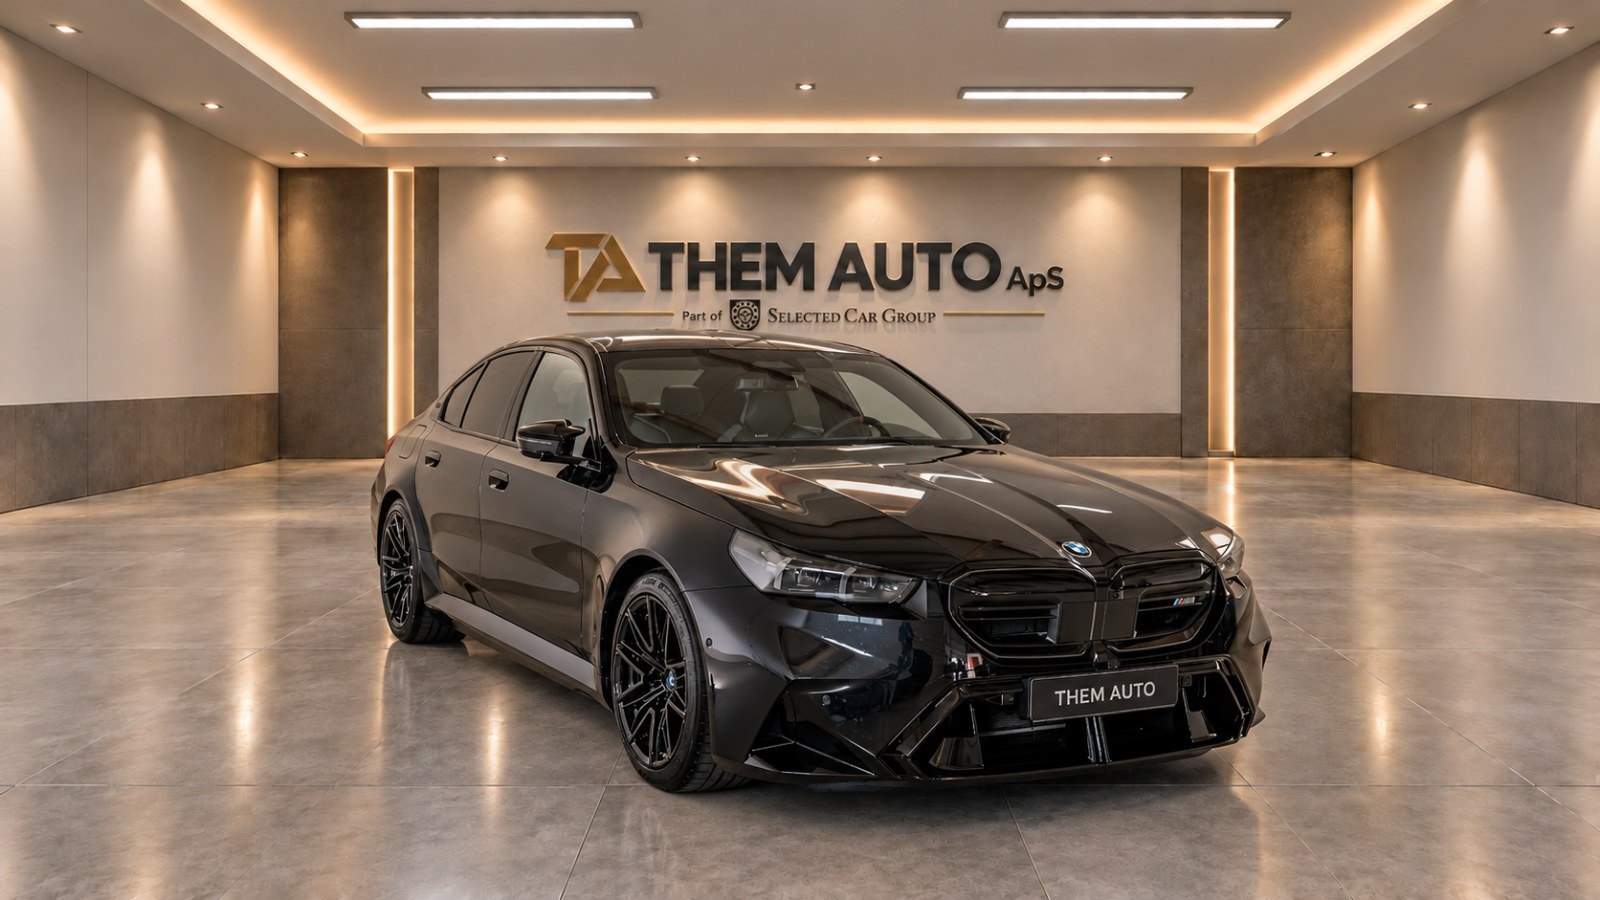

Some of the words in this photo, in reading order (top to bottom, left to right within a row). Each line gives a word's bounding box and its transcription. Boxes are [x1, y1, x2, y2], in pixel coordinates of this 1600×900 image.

[648, 242, 815, 291] THEM
[828, 242, 1002, 292] AUTO
[1006, 266, 1065, 297] ApS
[682, 311, 706, 321] Part
[710, 310, 722, 321] of
[1054, 686, 1105, 706] THEM
[1109, 681, 1156, 701] AUTO
